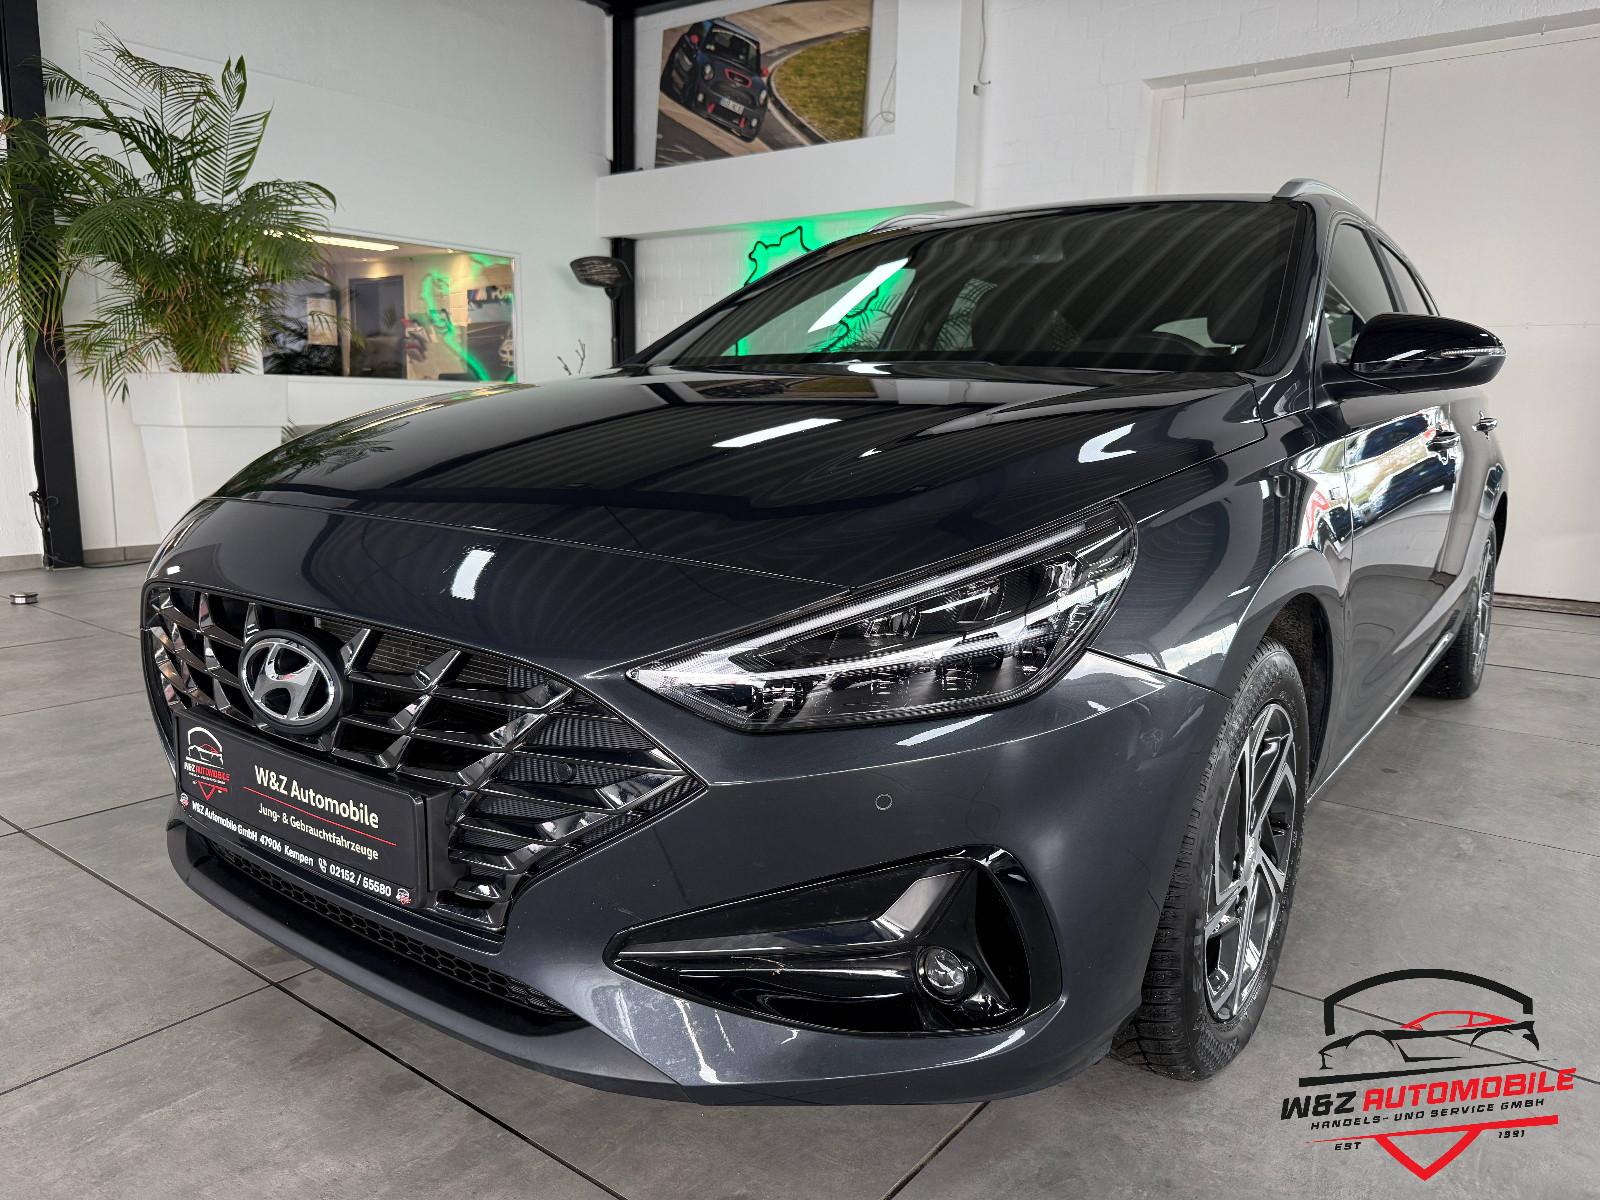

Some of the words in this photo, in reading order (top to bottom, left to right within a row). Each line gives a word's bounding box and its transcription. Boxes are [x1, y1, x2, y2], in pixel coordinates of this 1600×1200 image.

[254, 764, 288, 796] W&Z
[290, 782, 380, 829] Automobile
[191, 800, 206, 816] W&Z
[204, 808, 237, 832] Automobile
[237, 824, 258, 842] GmbH
[259, 834, 282, 852] 47906
[284, 844, 314, 867] Kempen
[329, 863, 356, 884] 02152
[362, 876, 392, 897] 55580
[258, 802, 281, 822] Jung-
[281, 812, 289, 825] &
[289, 815, 379, 861] Gebrauchtfahrzeuge
